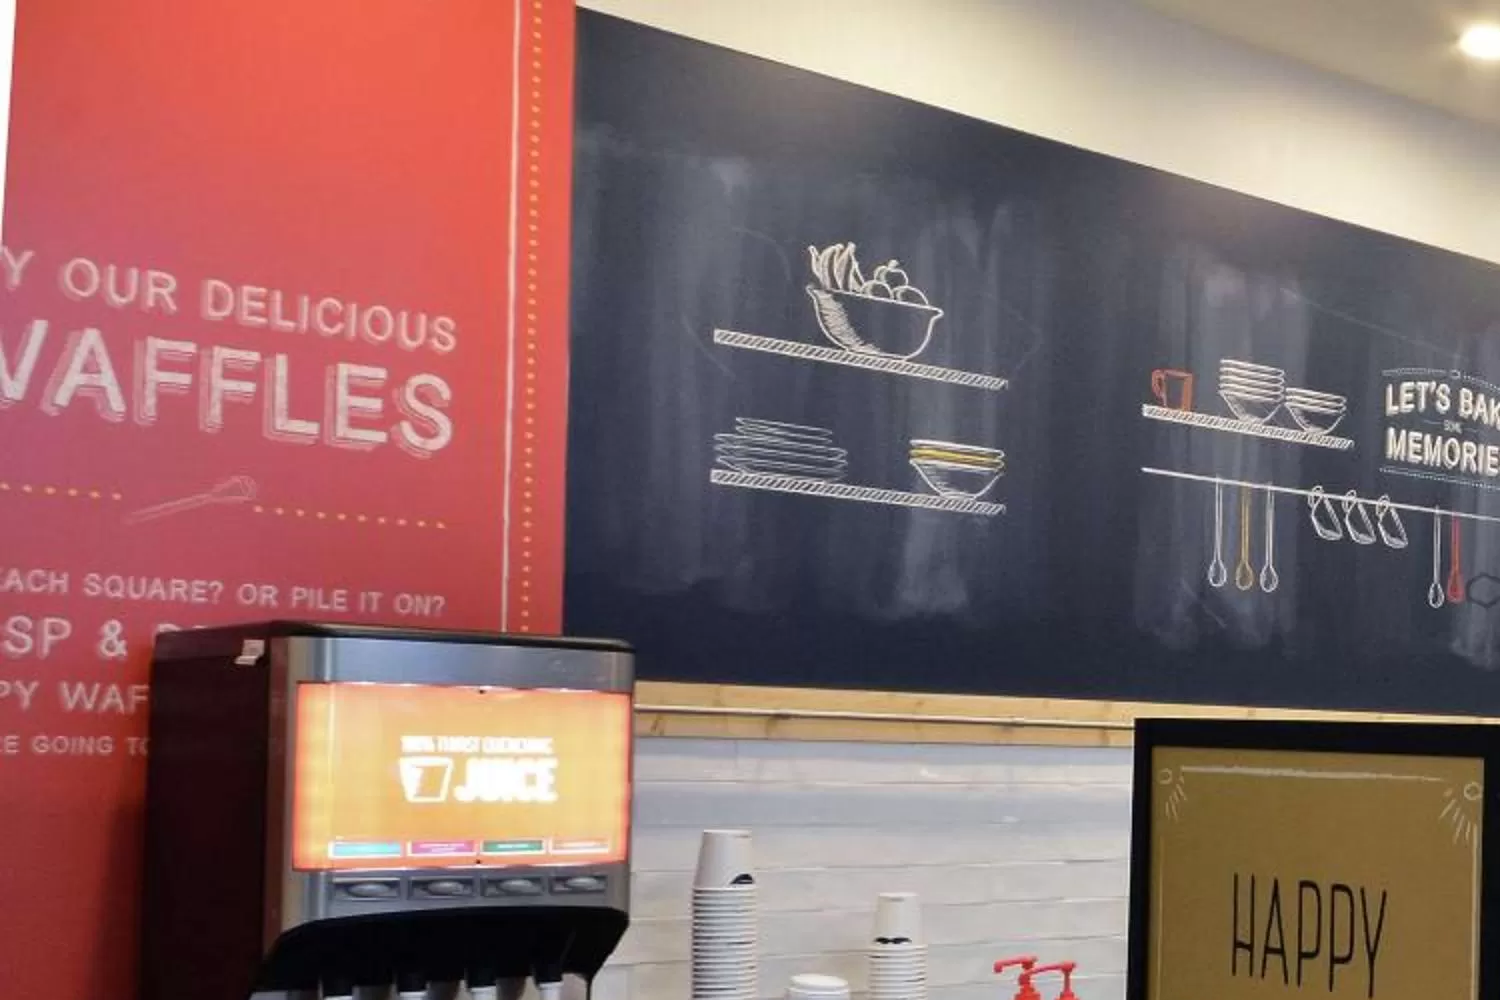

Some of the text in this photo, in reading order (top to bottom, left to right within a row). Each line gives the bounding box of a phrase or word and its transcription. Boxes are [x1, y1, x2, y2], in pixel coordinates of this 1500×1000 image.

[59, 257, 178, 313] OUR
[202, 279, 457, 353] DELICIOUS
[1385, 380, 1451, 416] LET'S
[0, 567, 446, 616] ACH SQUARE? OR PILE IT ON?
[98, 619, 128, 659] &
[32, 735, 114, 757] GOING
[1231, 871, 1388, 1000] HAPPY
